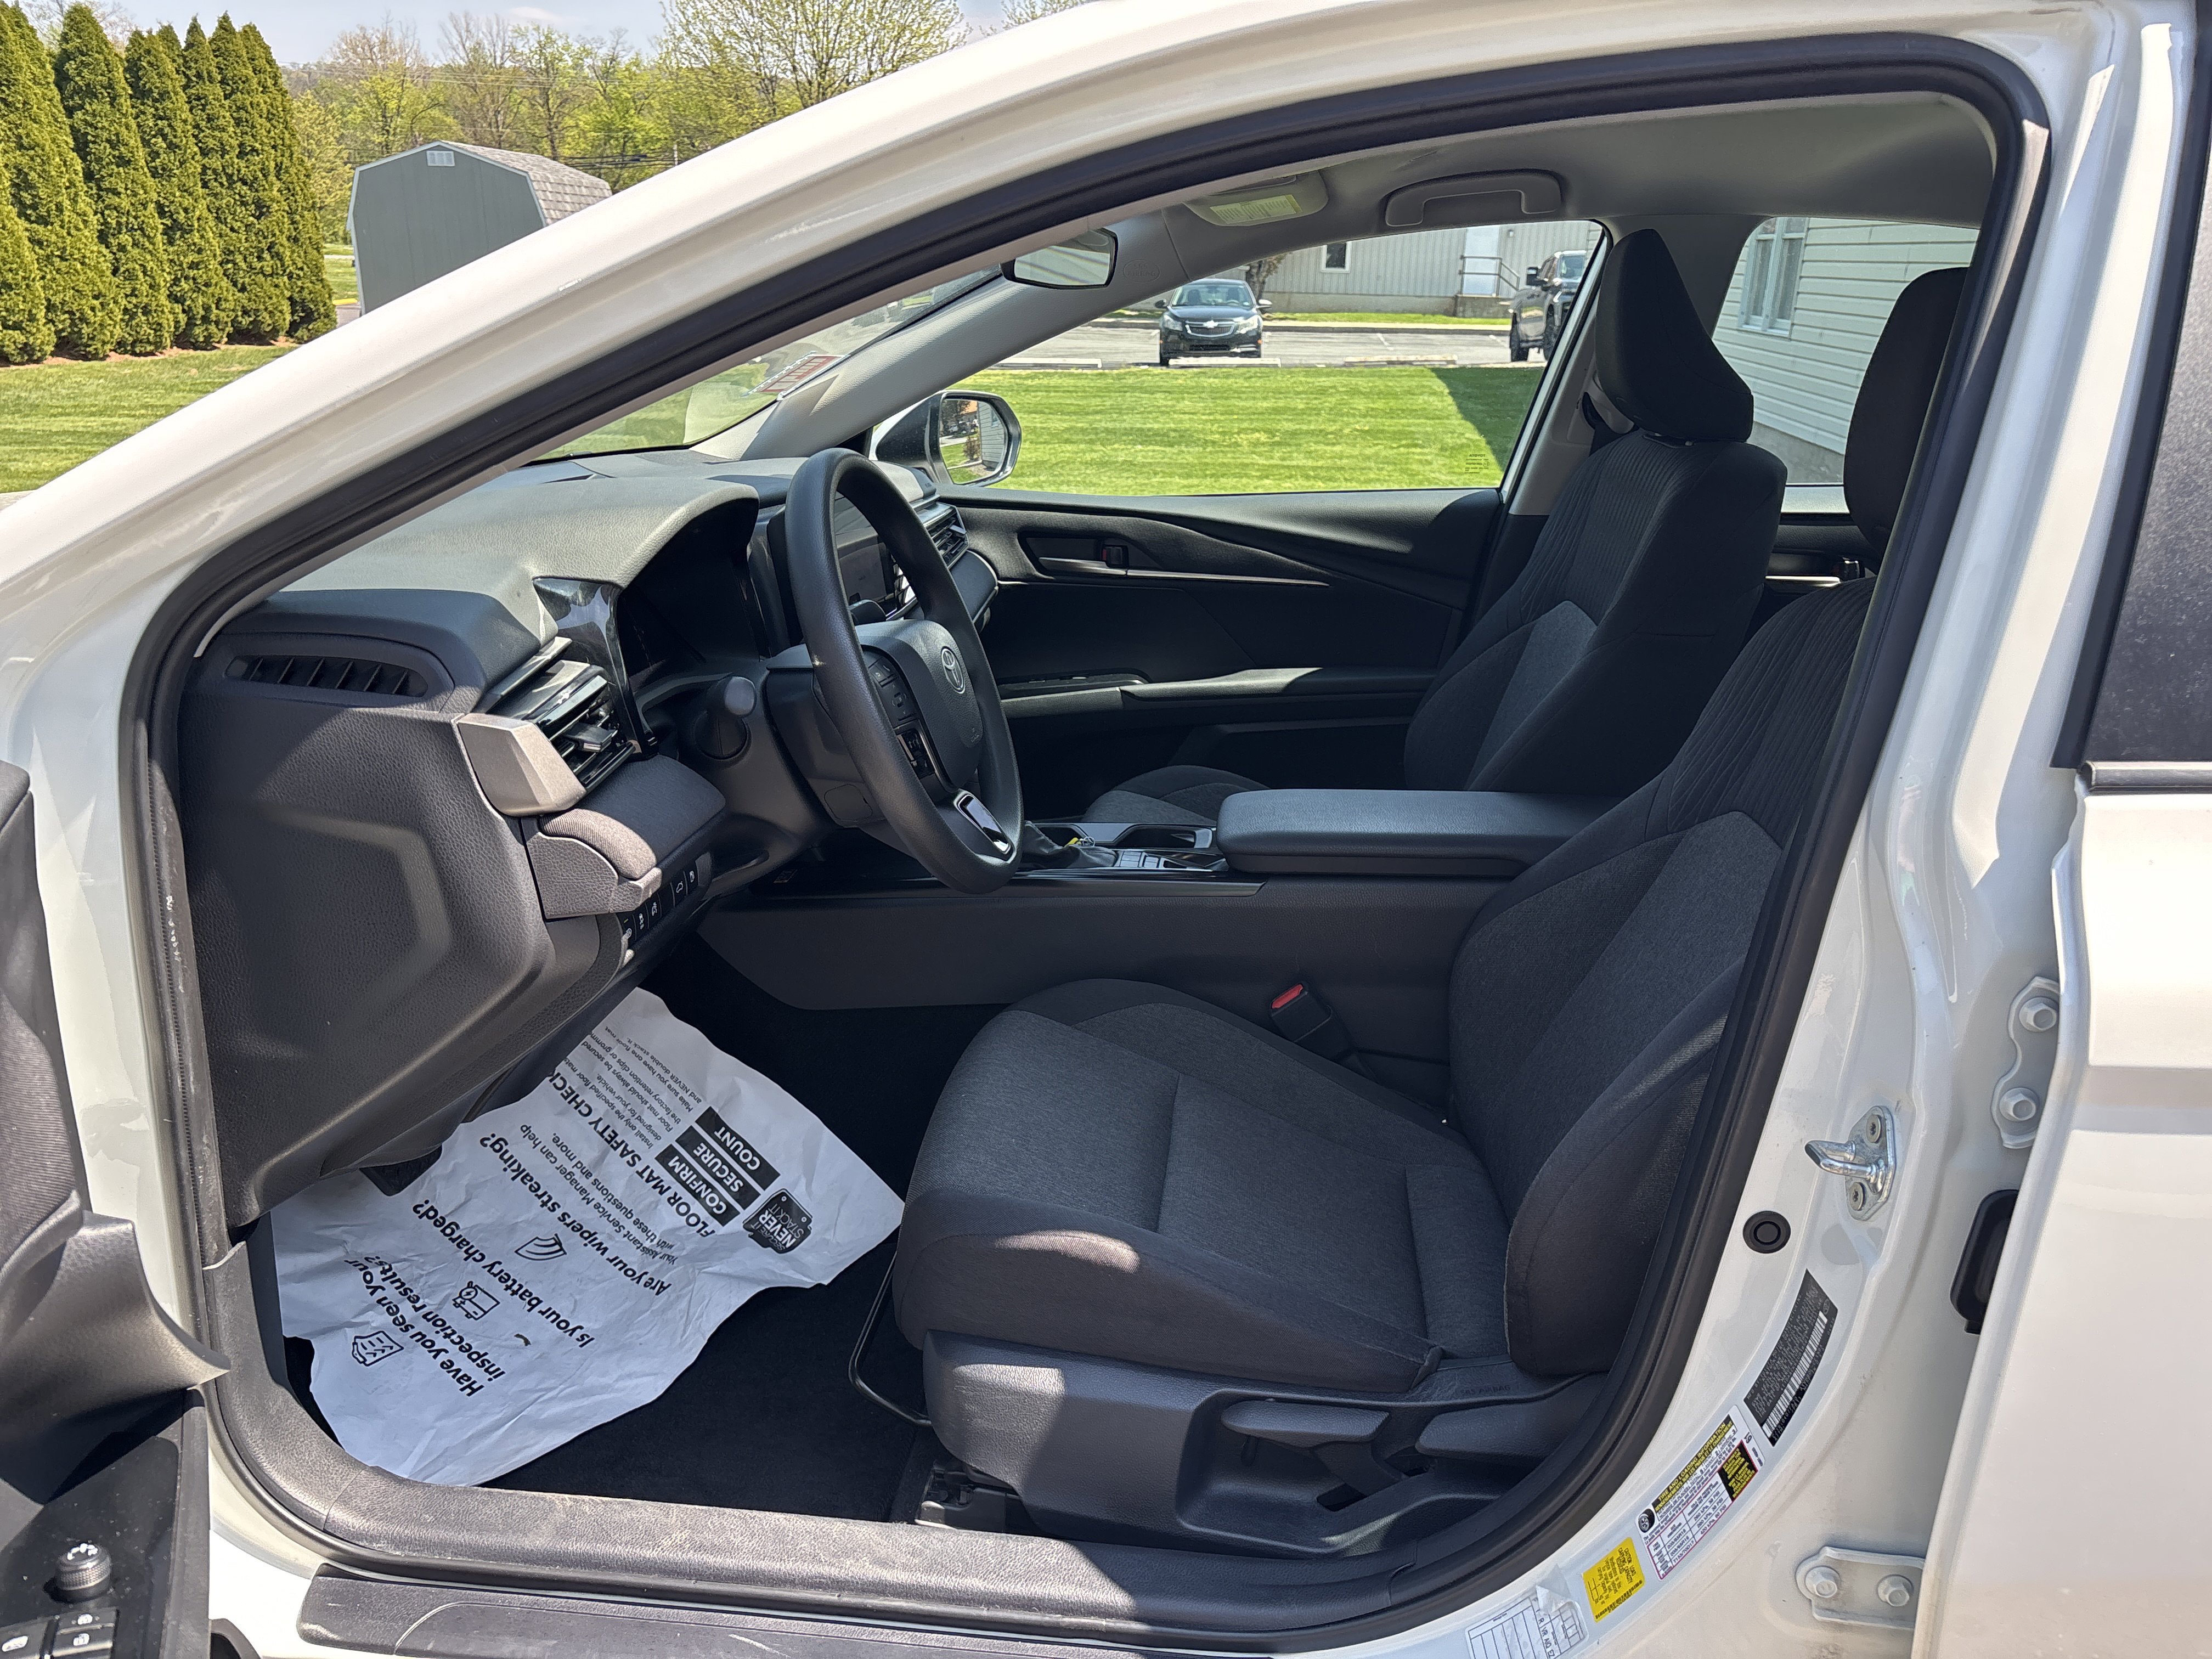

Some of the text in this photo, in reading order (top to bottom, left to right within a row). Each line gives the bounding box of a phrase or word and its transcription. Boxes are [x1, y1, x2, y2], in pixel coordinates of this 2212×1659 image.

[617, 1059, 630, 1071] clips
[631, 1050, 642, 1060] one
[643, 1060, 656, 1075] have
[650, 1056, 670, 1074] double
[577, 1073, 591, 1086] floor
[581, 1041, 673, 1132] Floor mat should always be secured
[629, 1071, 653, 1095] retention
[656, 1073, 669, 1085] you
[667, 1084, 679, 1097] sure
[670, 1074, 690, 1093] NEVER
[589, 1085, 616, 1110] specified
[597, 1074, 661, 1140] designed for your vehicle.
[652, 1094, 672, 1115] factory
[679, 1096, 693, 1112] Make
[689, 1092, 702, 1103] and
[615, 1110, 625, 1120] the
[624, 1119, 636, 1130] only
[671, 1113, 681, 1124] the
[552, 1133, 577, 1161] more.
[588, 1117, 641, 1167] SAFETY
[634, 1130, 653, 1149] Install
[714, 1127, 760, 1170] COUNT
[572, 1160, 592, 1180] and
[636, 1165, 672, 1195] MAT
[693, 1143, 743, 1192] SECURE
[521, 1125, 678, 1264] Your Assistant Service Manager can help
[668, 1156, 726, 1214] CONFIRM
[591, 1178, 633, 1219] questions
[480, 1133, 672, 1295] Are your wipers streaking?
[667, 1192, 715, 1237] FLOOR
[768, 1203, 805, 1239] STACK IT
[633, 1218, 656, 1243] these
[749, 1221, 786, 1251] SECURE IT
[757, 1209, 797, 1249] NEVER
[413, 1200, 595, 1347] Is your battery charged?
[344, 1260, 484, 1396] Have you seen your
[364, 1256, 505, 1381] inspection results?
[1658, 1488, 1669, 1502] TIRE
[1668, 1476, 1679, 1491] AND
[1678, 1455, 1698, 1480] LOADING
[1696, 1422, 1726, 1458] INFORMATION
